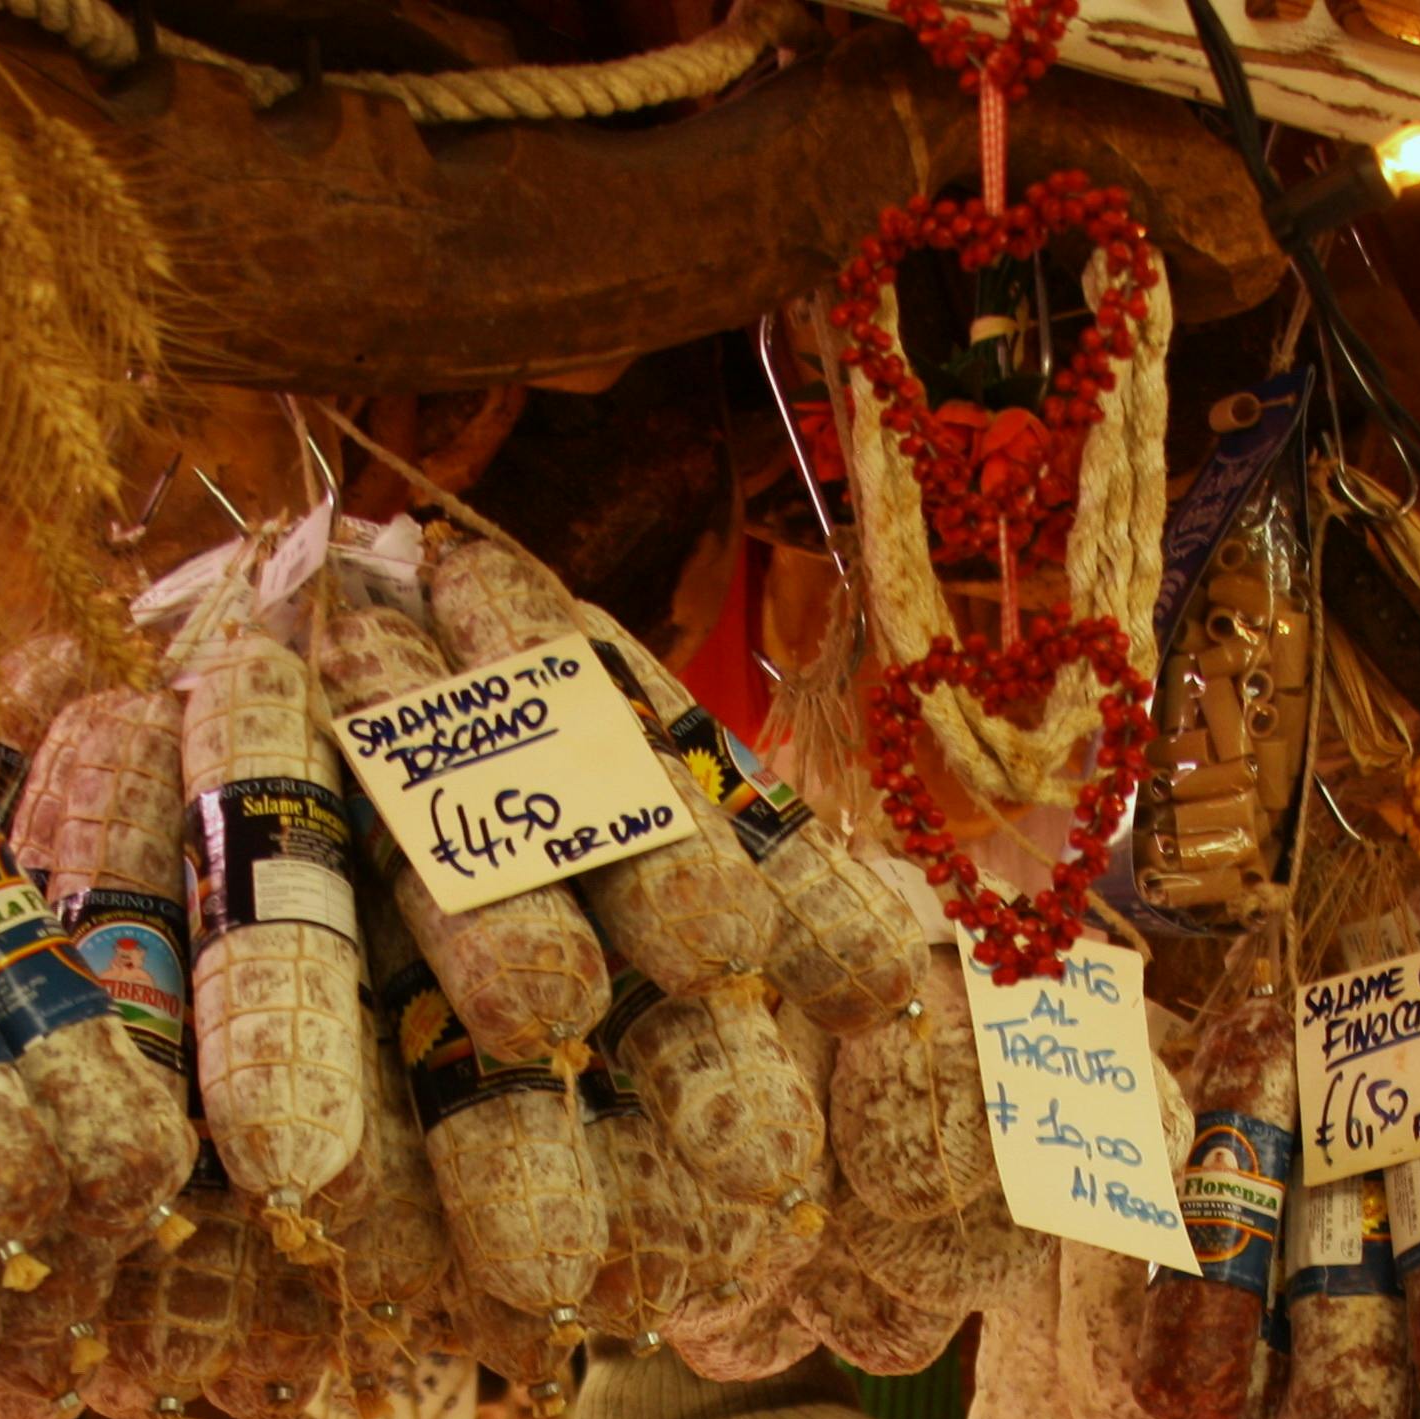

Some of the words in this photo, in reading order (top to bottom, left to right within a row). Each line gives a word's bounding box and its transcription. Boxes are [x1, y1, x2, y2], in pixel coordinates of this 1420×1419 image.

[384, 697, 548, 785] TOSCANO
[242, 793, 303, 818] Salame
[1303, 966, 1405, 1027] SALAME
[983, 1018, 1137, 1093] TARTUFO
